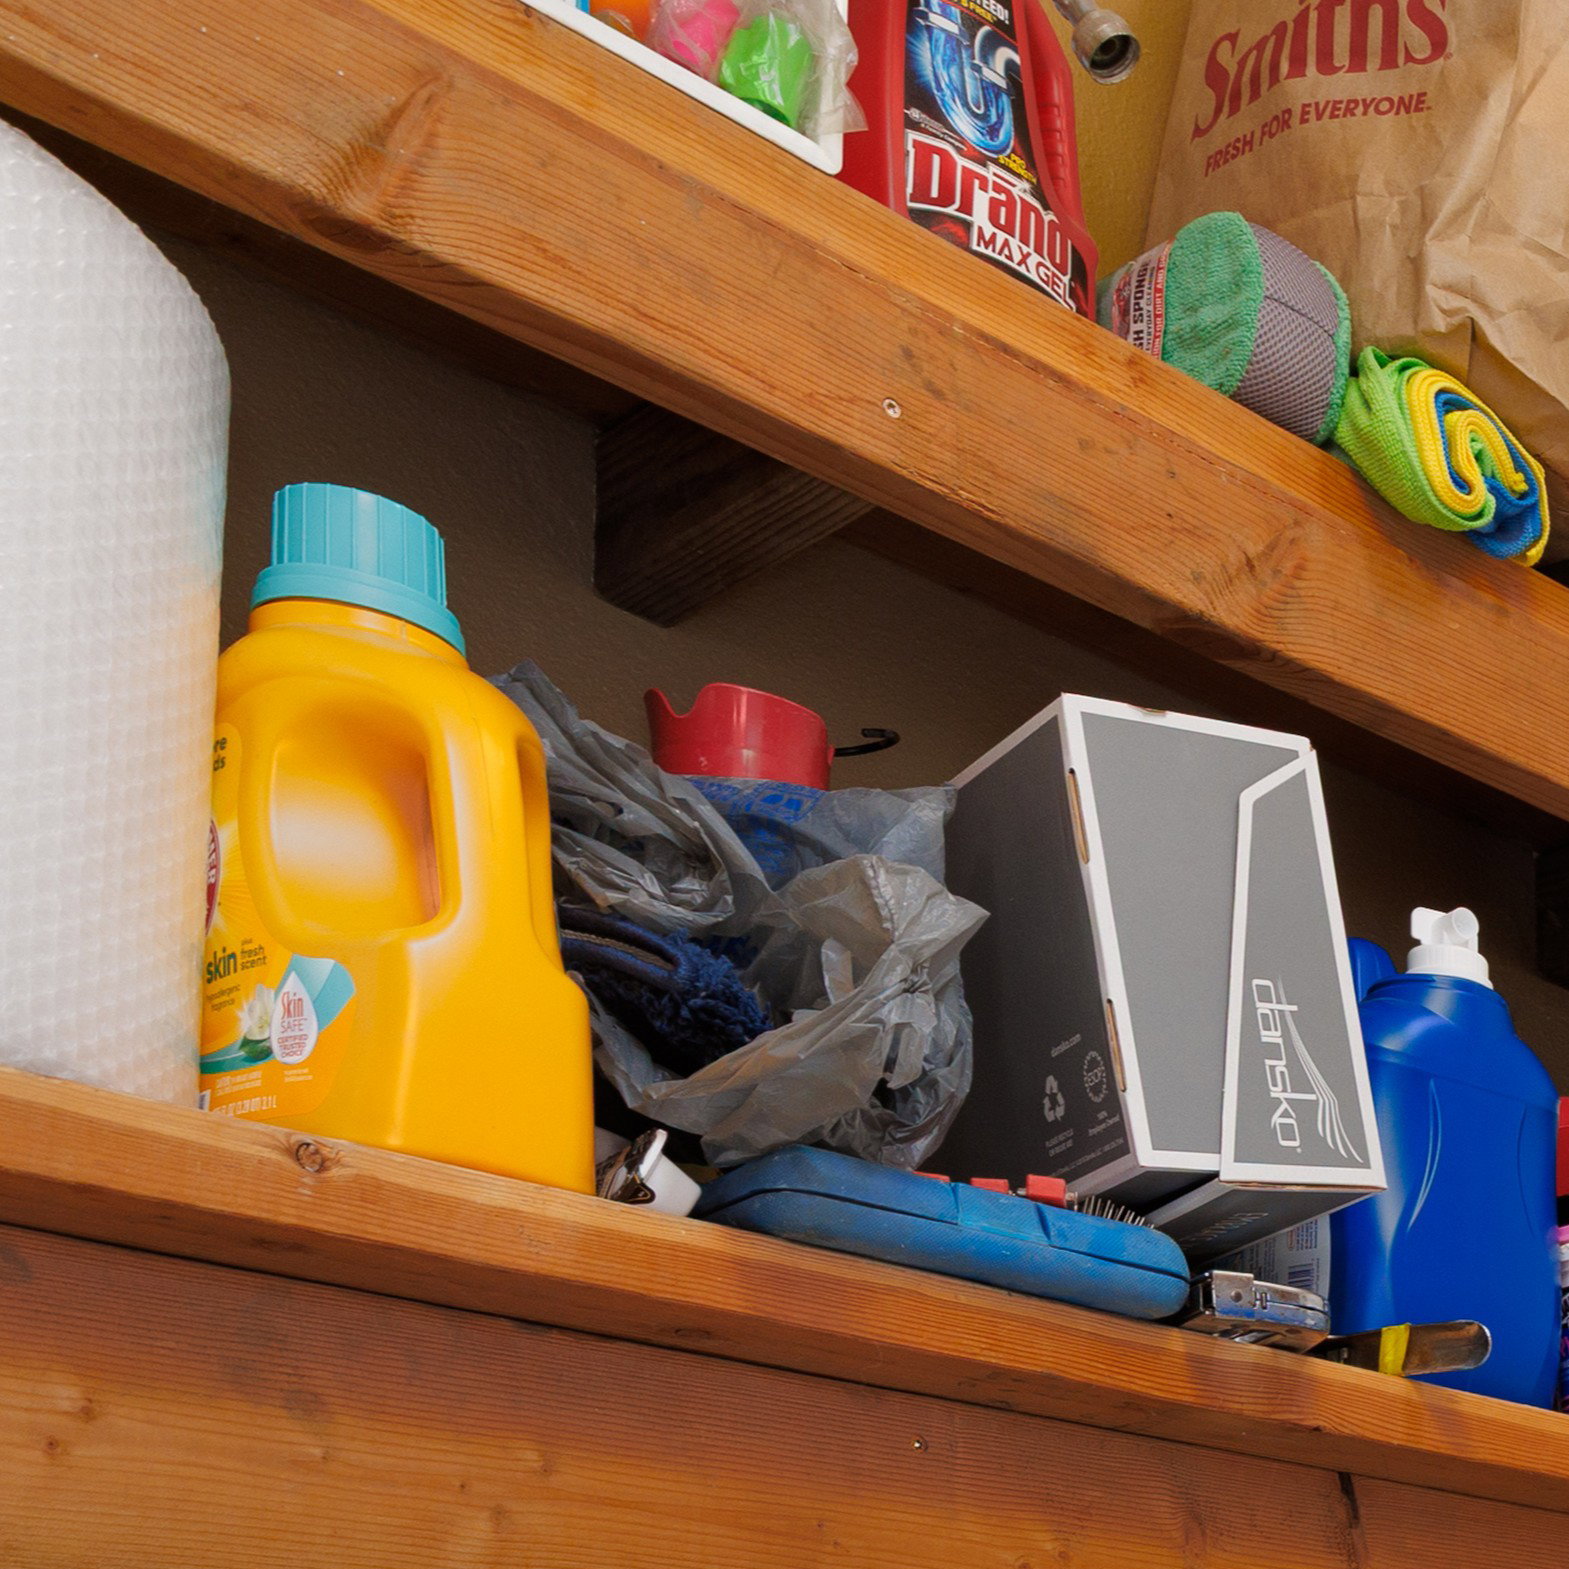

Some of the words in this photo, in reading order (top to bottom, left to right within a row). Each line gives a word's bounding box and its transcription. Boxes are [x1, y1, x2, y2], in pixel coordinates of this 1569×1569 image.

[1203, 130, 1254, 178] FRESH
[1259, 107, 1293, 147] FOR
[976, 224, 1033, 273] MAX
[1034, 259, 1073, 310] GEL
[205, 946, 238, 985] skin
[239, 955, 268, 972] scent
[240, 944, 265, 959] fresh
[281, 991, 305, 1021] Skin
[281, 1018, 305, 1034] SAFE
[1252, 978, 1318, 1148] dansko
